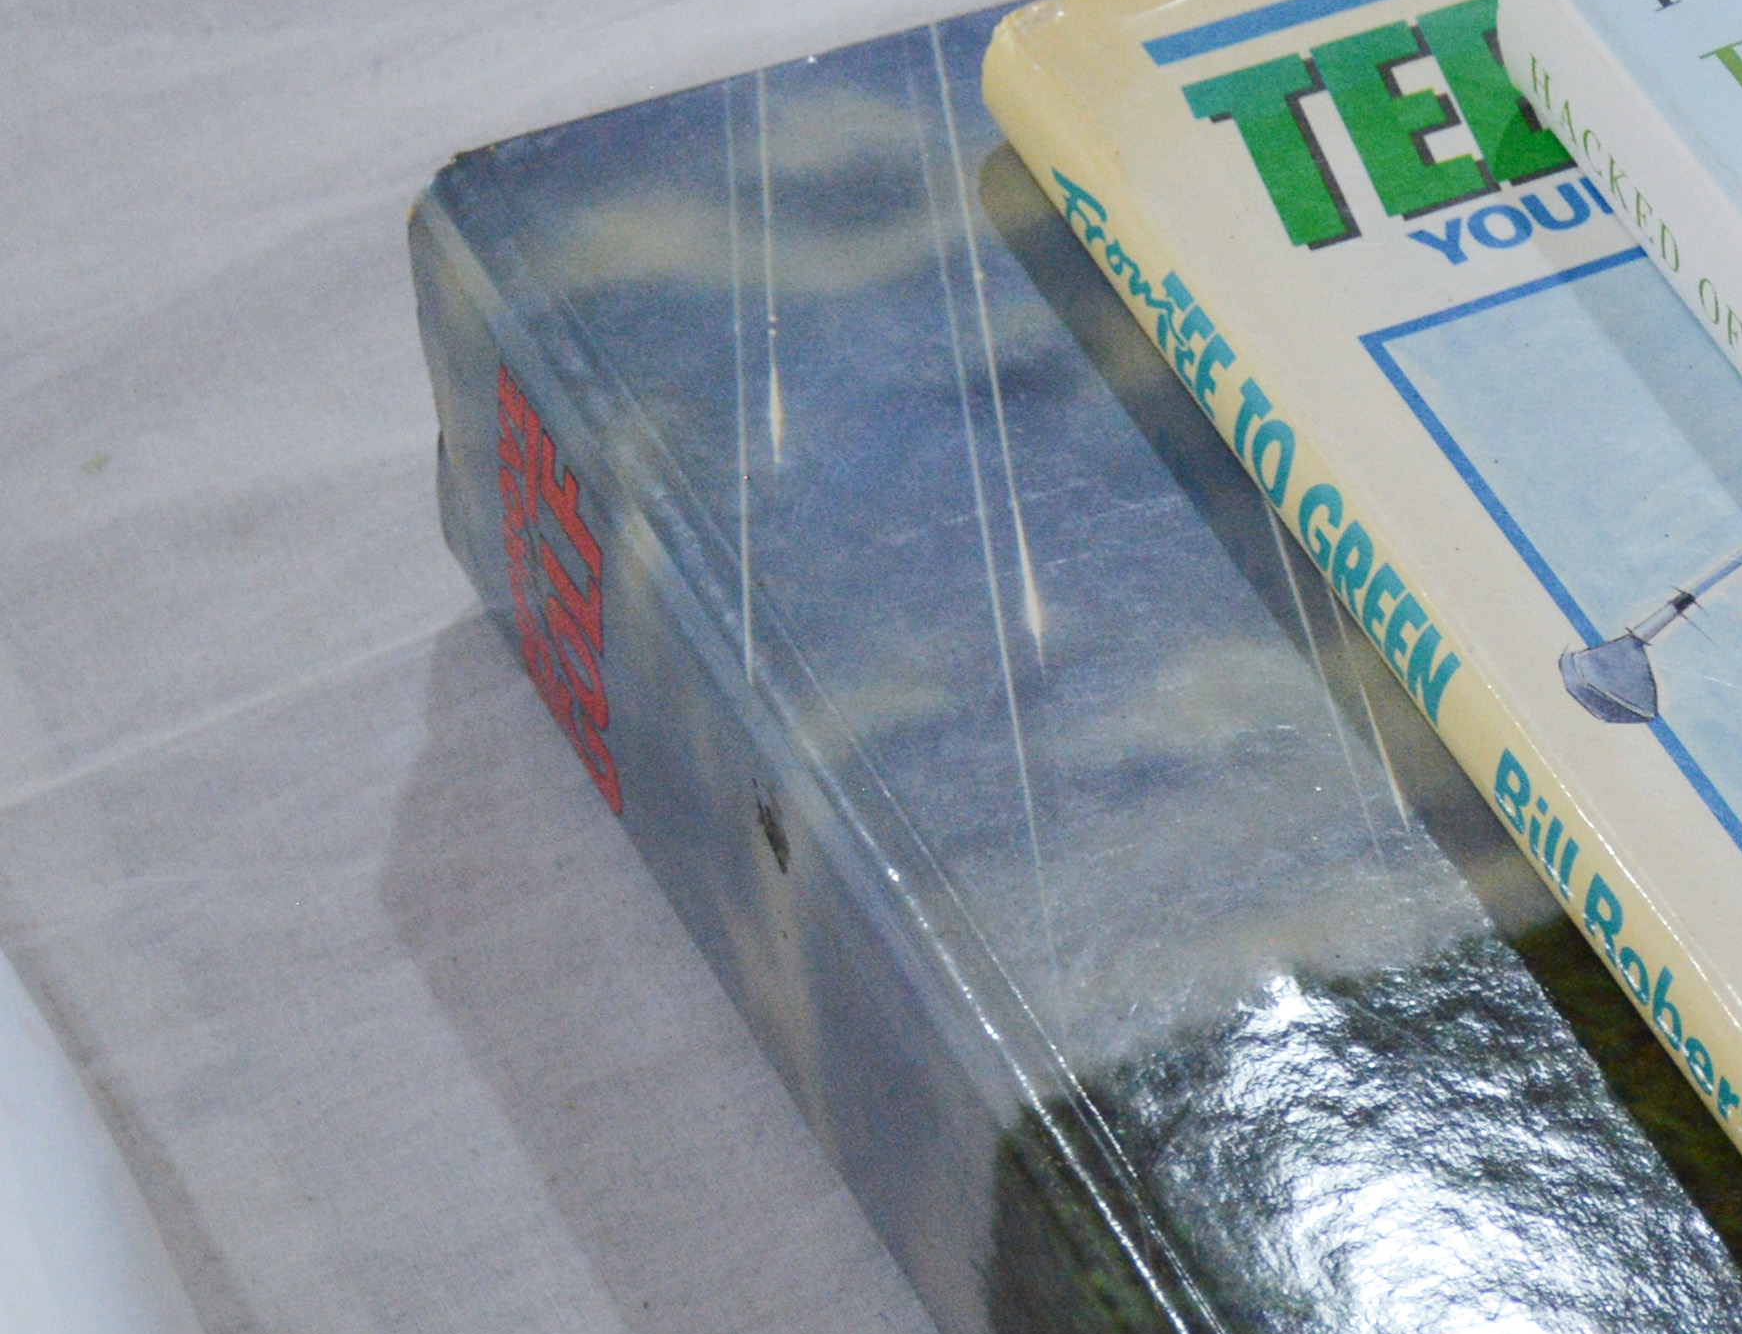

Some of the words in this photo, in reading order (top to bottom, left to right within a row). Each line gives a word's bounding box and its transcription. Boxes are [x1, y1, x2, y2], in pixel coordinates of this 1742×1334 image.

[1406, 176, 1613, 265] YOU
[1529, 52, 1680, 274] HACKED
[1052, 166, 1187, 348] From
[1234, 377, 1296, 508] TO
[1298, 483, 1462, 728] GREEN
[1494, 747, 1579, 903] Bill
